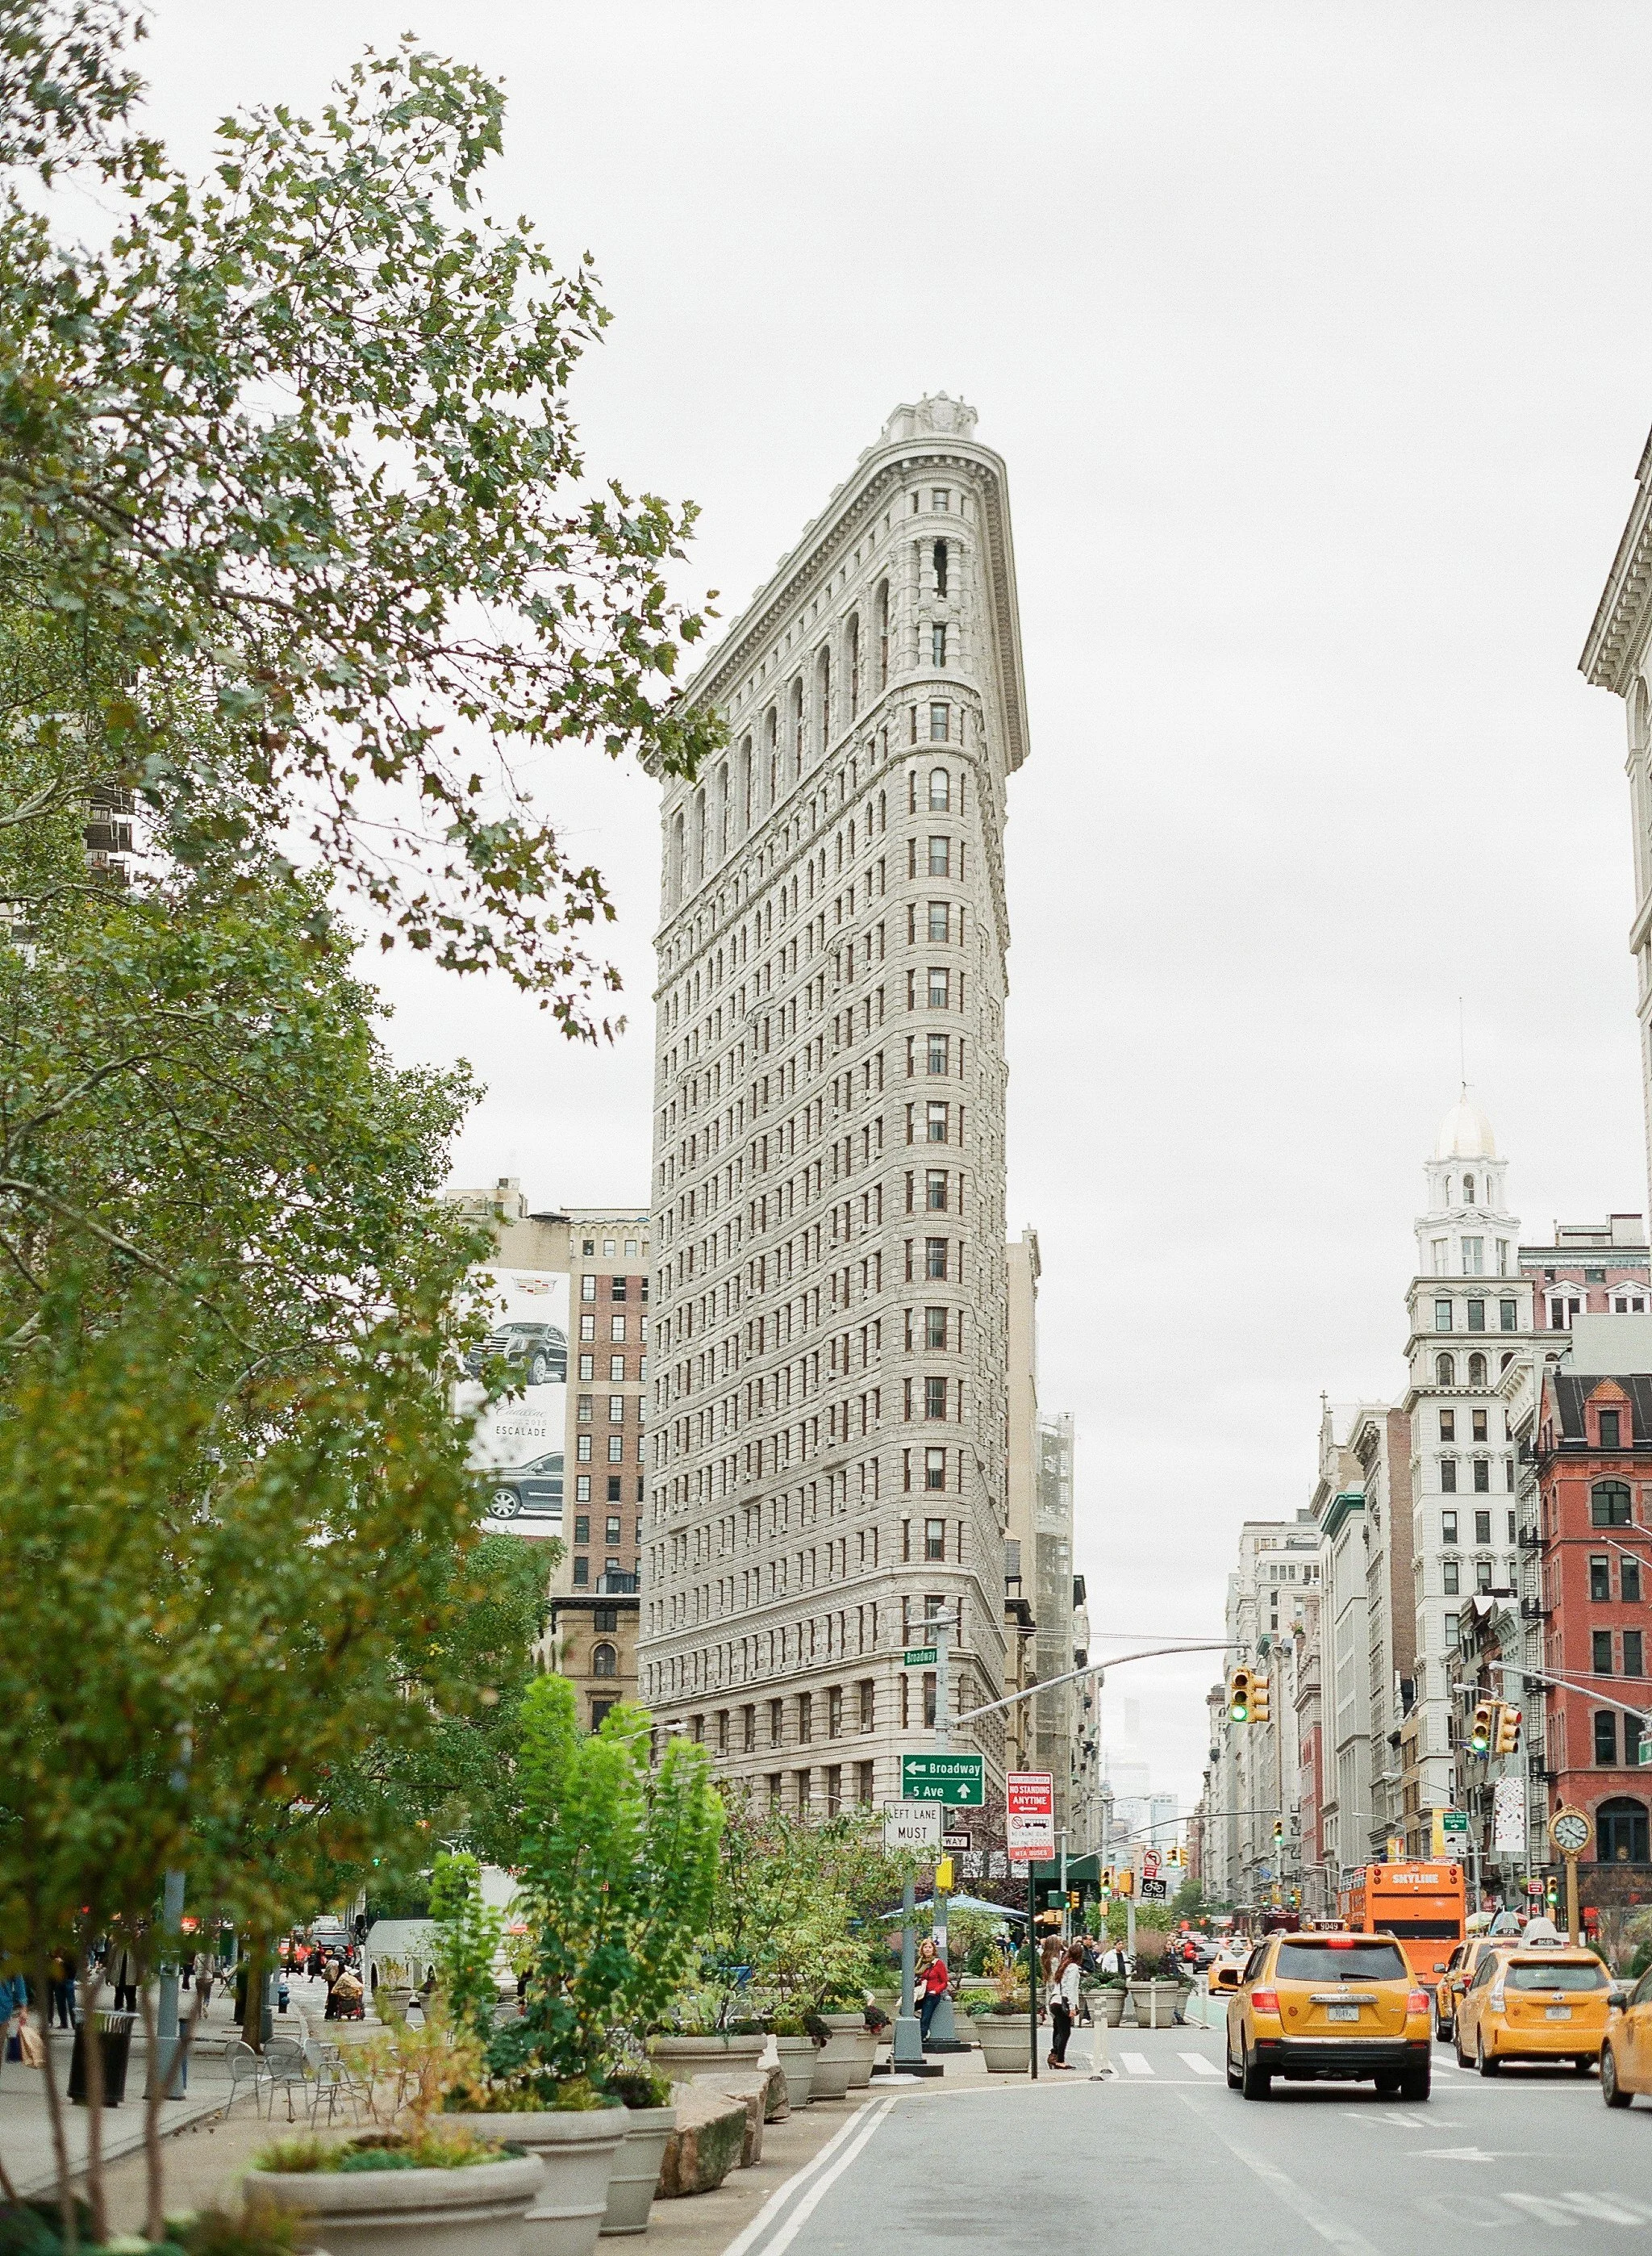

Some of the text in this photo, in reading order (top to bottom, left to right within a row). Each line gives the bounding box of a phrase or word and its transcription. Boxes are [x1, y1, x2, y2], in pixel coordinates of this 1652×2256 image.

[496, 1426, 546, 1437] ESCALADE
[907, 1650, 936, 1663] Broadway
[929, 1763, 981, 1777] Broadway
[913, 1786, 944, 1797] 5 Ave
[1009, 1786, 1050, 1794] NO STANDING
[1012, 1796, 1047, 1805] ANYTIME
[914, 1809, 937, 1819] LANE
[898, 1827, 927, 1839] MUST
[945, 1838, 963, 1846] WAY
[1392, 1874, 1439, 1884] SKYLINE
[1320, 1922, 1338, 1931] 9D49
